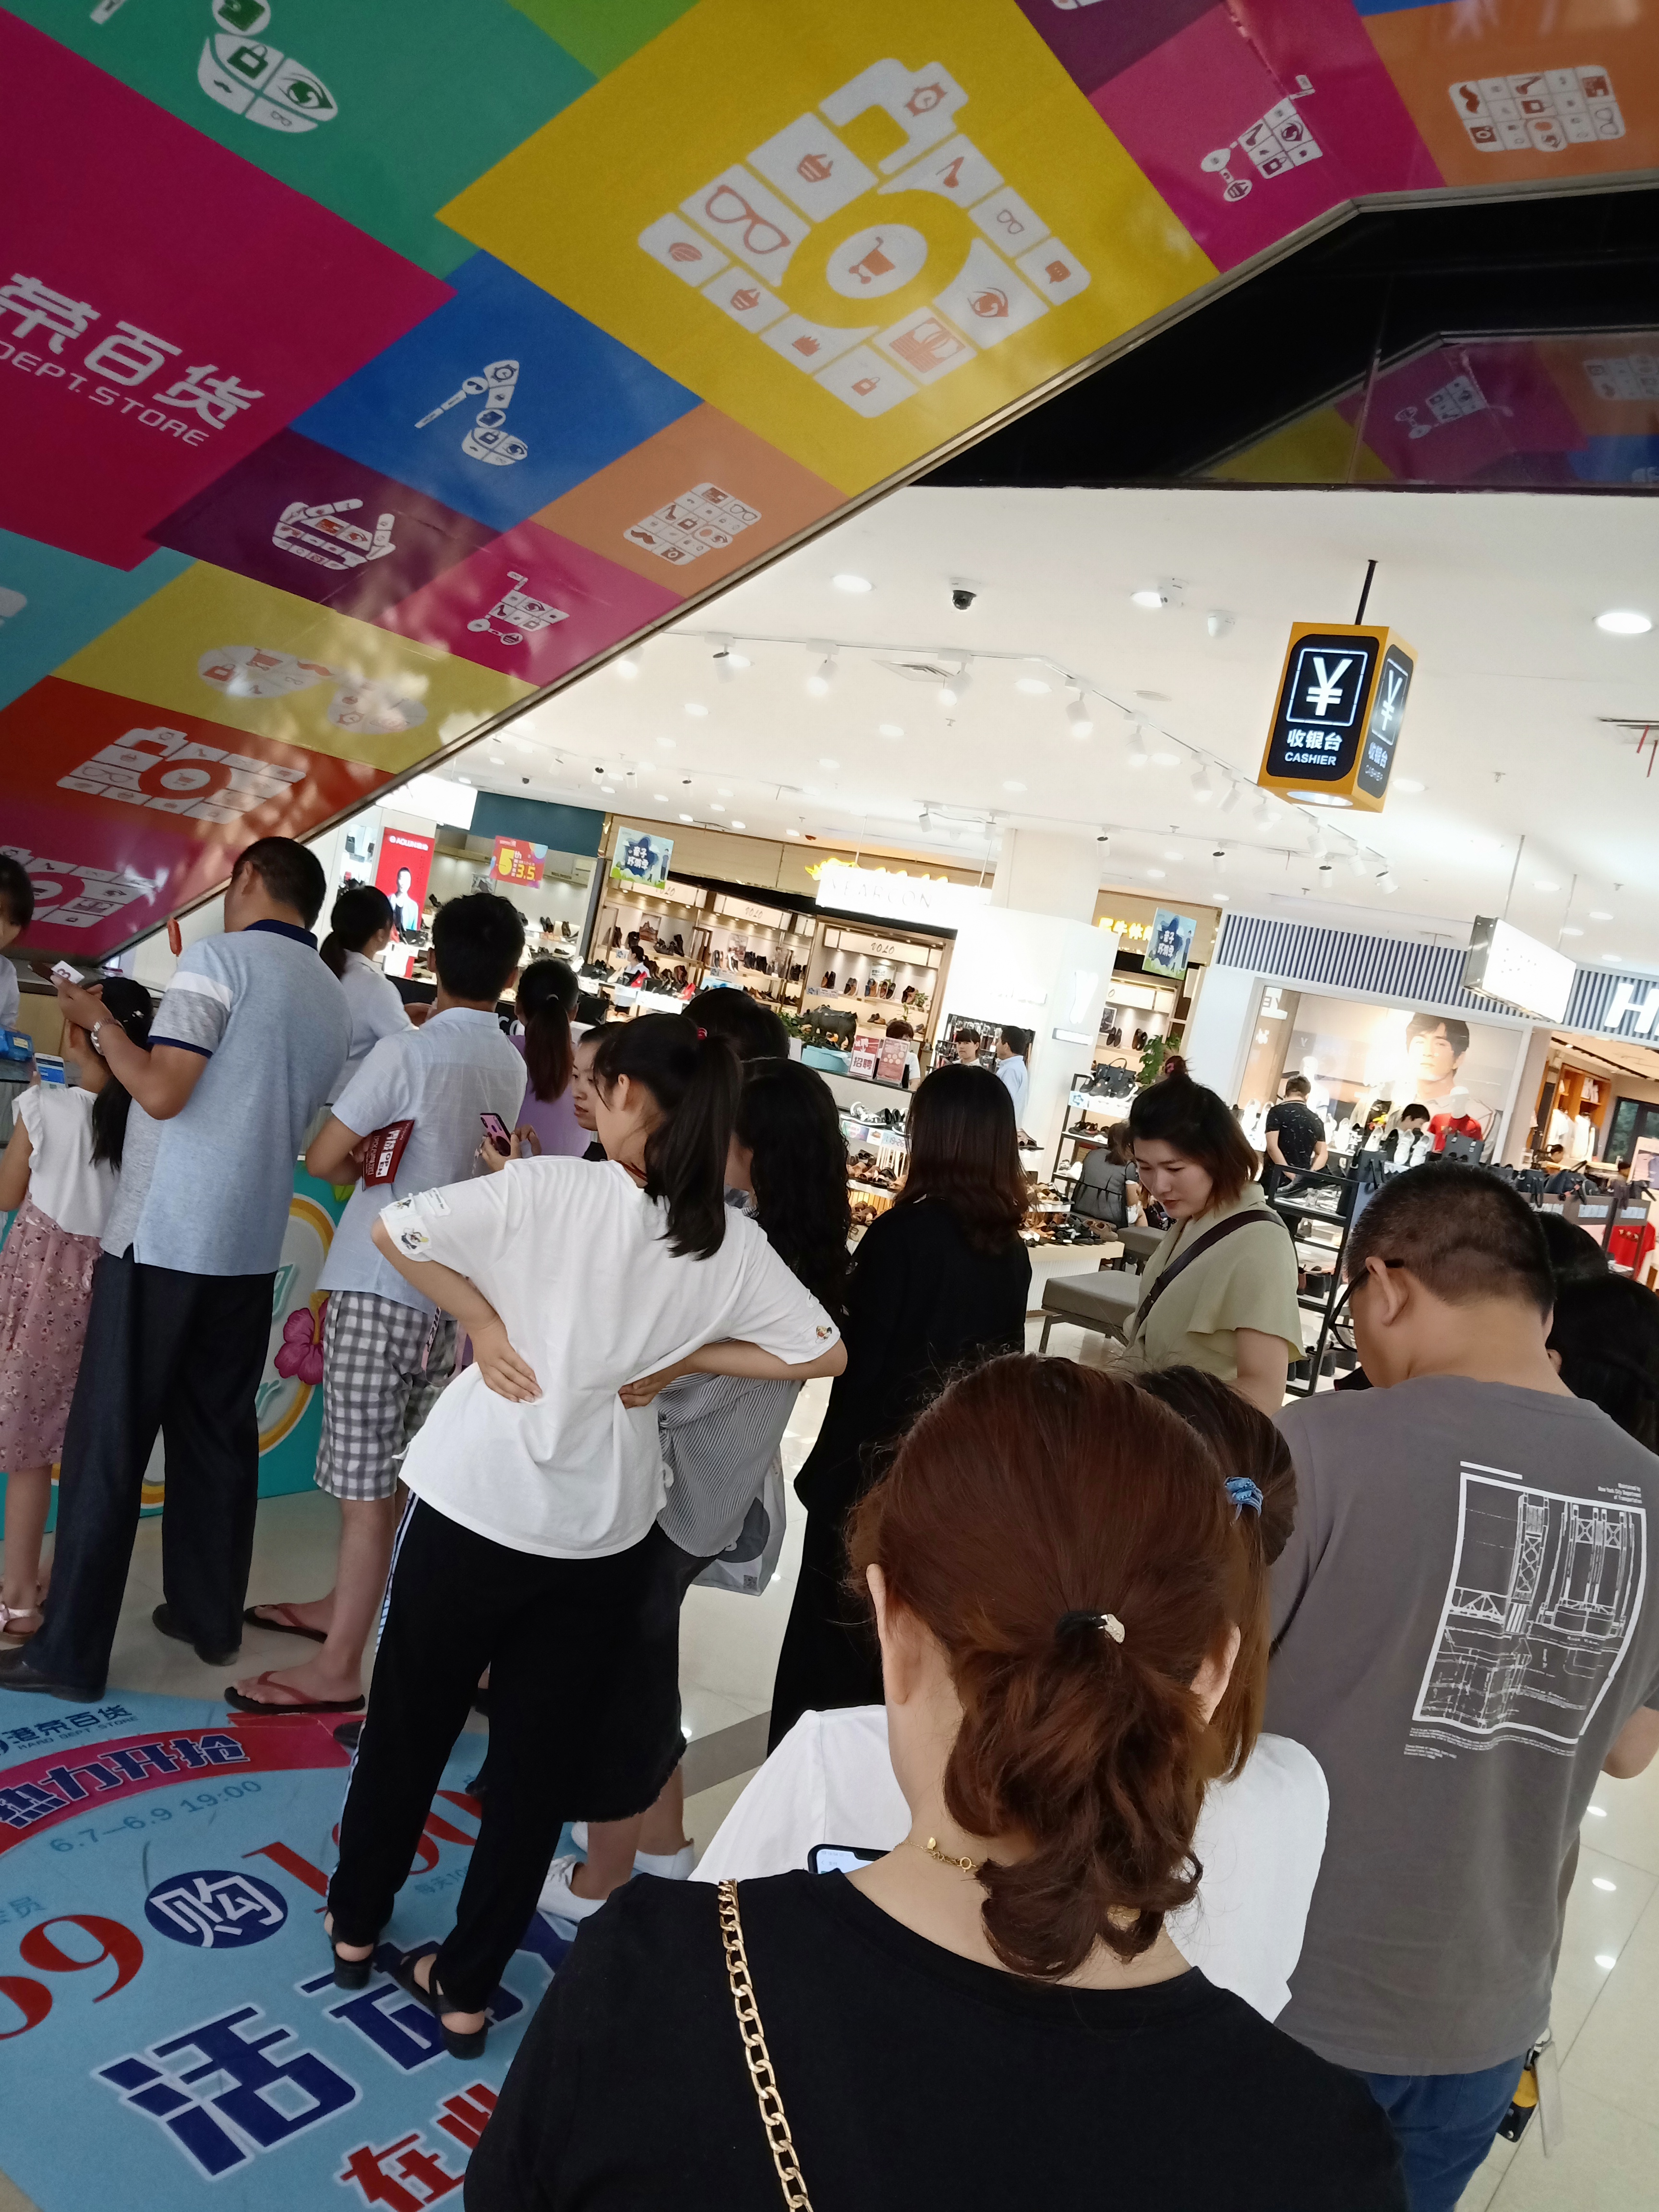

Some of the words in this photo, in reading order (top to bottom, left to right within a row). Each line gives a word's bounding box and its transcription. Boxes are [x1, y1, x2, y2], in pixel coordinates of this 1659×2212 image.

[88, 386, 209, 446] STORE
[1286, 729, 1343, 752] 收银台
[1284, 752, 1336, 766] CASHIER
[871, 942, 895, 954] VOLO
[1604, 983, 1659, 1036] H
[853, 1057, 873, 1070] 招聘
[180, 1780, 262, 1814] 19:00
[148, 1875, 284, 1948] 购
